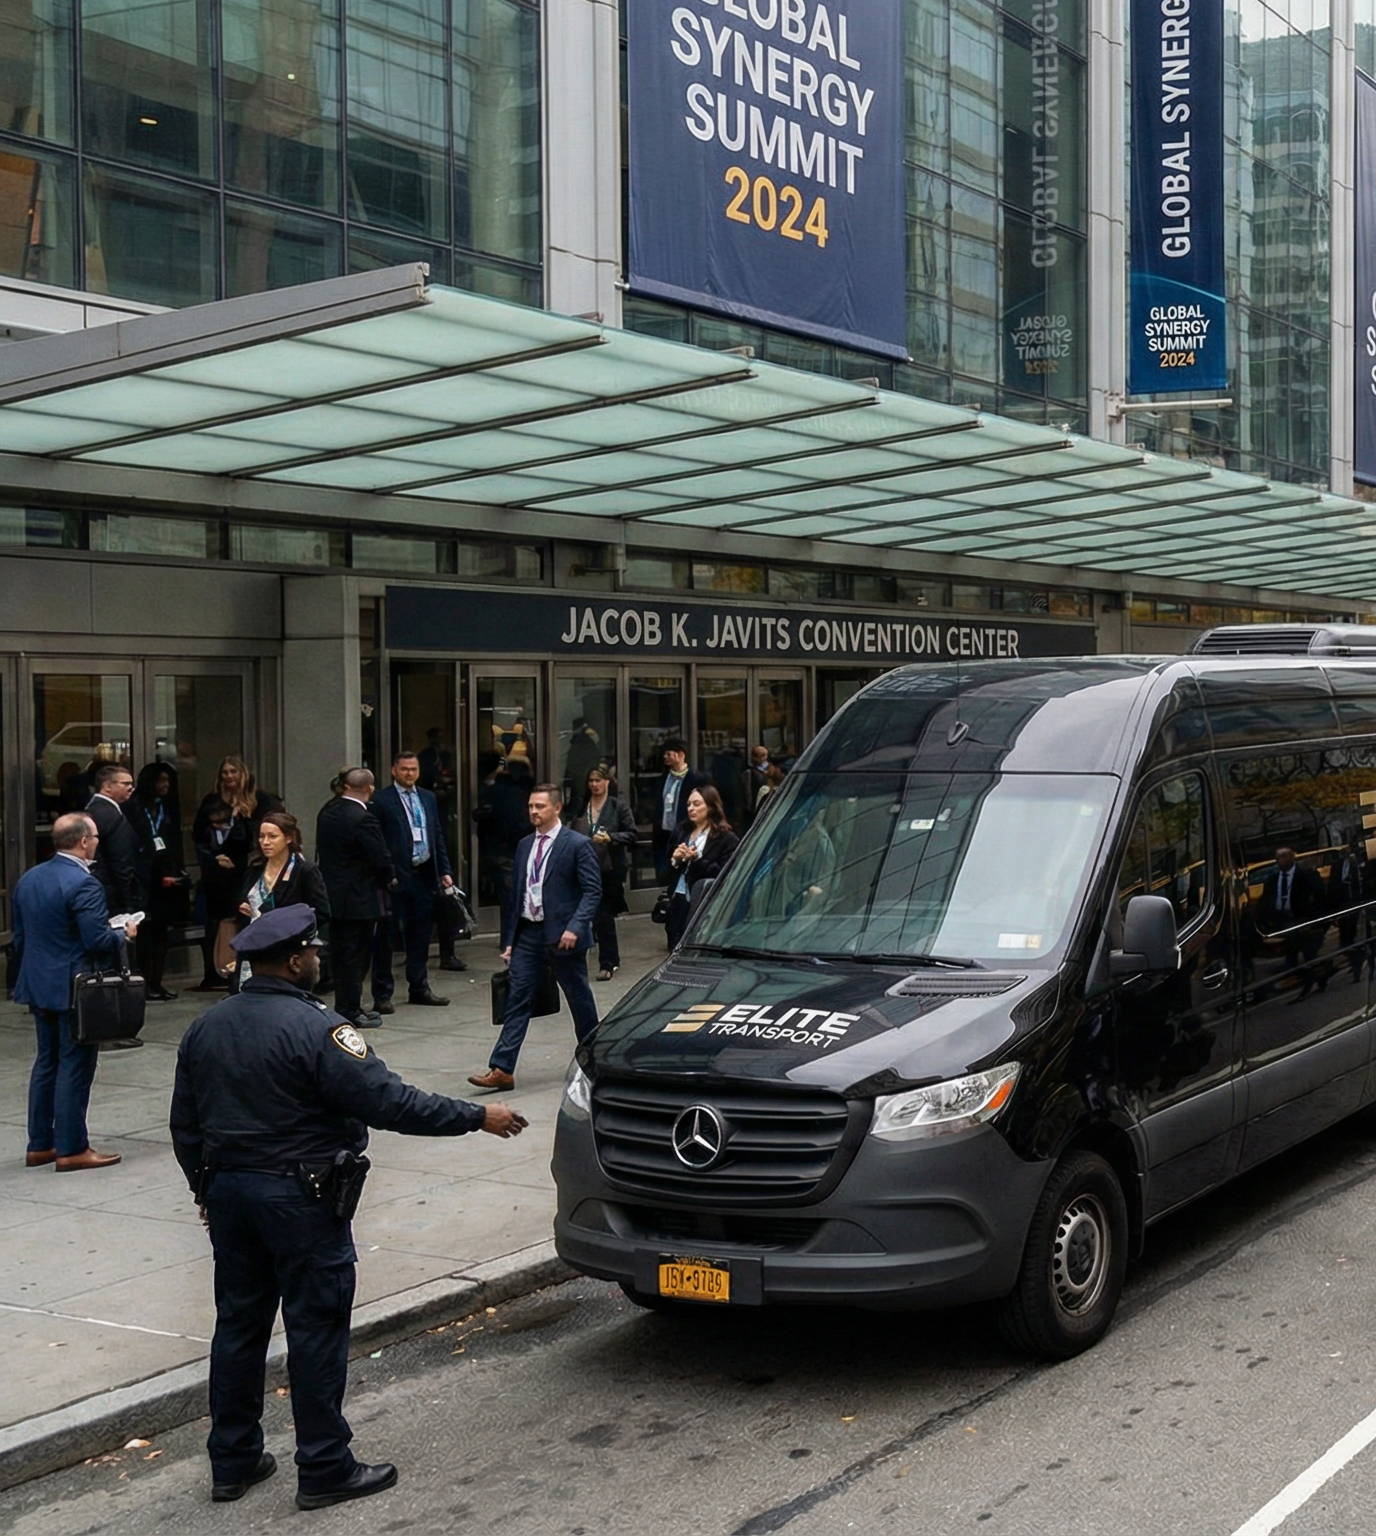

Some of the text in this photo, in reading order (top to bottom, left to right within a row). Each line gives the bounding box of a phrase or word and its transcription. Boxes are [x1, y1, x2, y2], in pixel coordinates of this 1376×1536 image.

[671, 7, 875, 136] SYNERGY
[685, 83, 864, 194] SUMMIT
[725, 166, 829, 248] 2024
[1161, 131, 1191, 258] GLOBAL
[1144, 319, 1211, 337] SYNERGY
[1150, 304, 1205, 321] GLOBAL
[1148, 335, 1207, 352] SUMMIT
[1159, 351, 1196, 368] 2024
[561, 606, 1019, 657] JACOB K. JAVITS CONVENTION CENTER
[708, 1022, 841, 1049] TRANSPORT
[718, 1004, 861, 1036] ELITE
